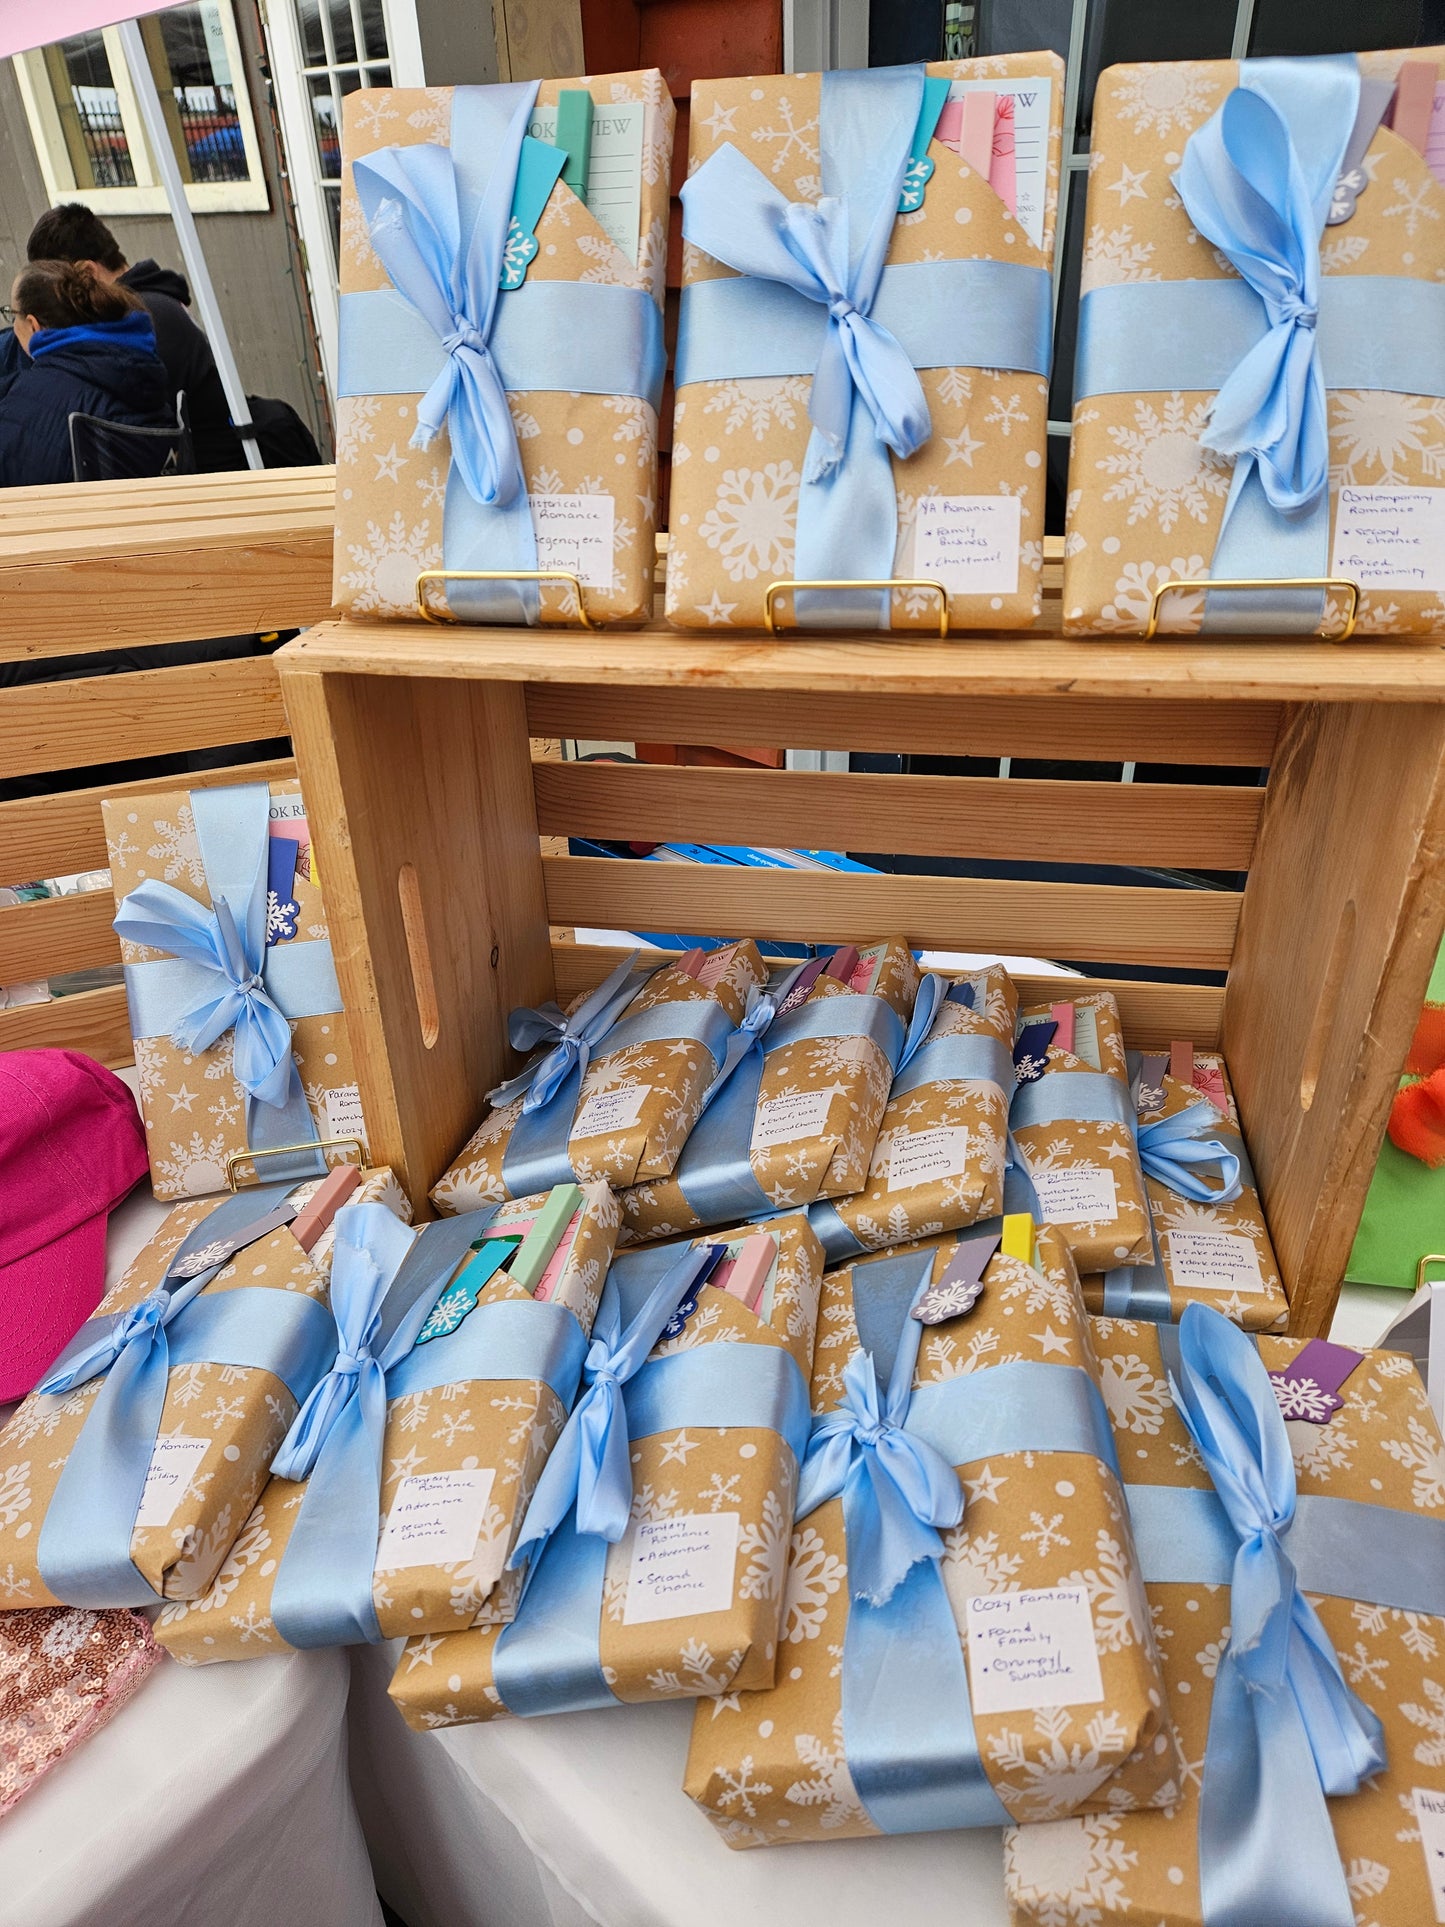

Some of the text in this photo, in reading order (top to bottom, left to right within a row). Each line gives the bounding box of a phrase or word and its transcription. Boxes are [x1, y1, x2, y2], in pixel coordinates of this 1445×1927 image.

[539, 509, 600, 519] Romance
[921, 501, 996, 515] YA Romance
[1349, 506, 1414, 515] Romance
[268, 805, 289, 819] OK
[329, 1090, 359, 1099] Parano
[160, 1440, 206, 1451] Romance
[146, 1473, 179, 1486] ilding
[651, 1530, 710, 1545] Romance
[648, 1544, 711, 1561] Adventure
[972, 1592, 1080, 1613] Cozy Fantasy
[988, 1621, 1032, 1638] Found
[998, 1633, 1051, 1648] Family
